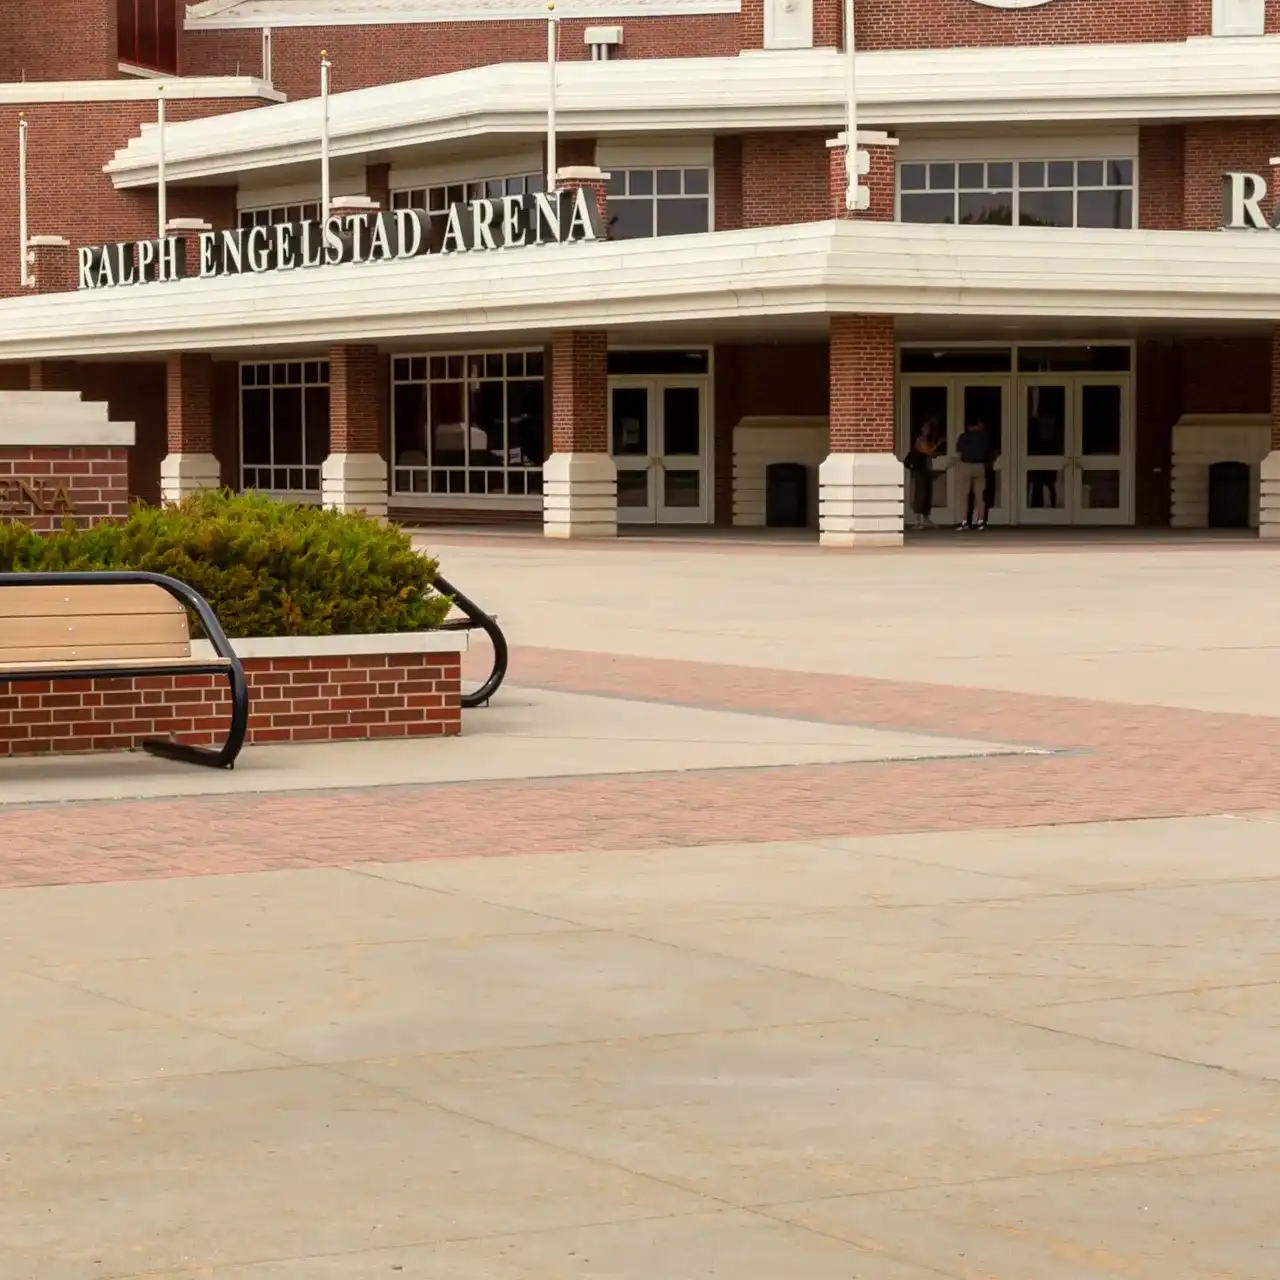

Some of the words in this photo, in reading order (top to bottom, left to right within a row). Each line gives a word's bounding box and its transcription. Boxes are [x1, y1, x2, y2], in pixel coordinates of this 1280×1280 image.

[78, 235, 180, 289] RALPH
[197, 207, 423, 279] ENGELSTAD
[440, 187, 597, 256] ARENA
